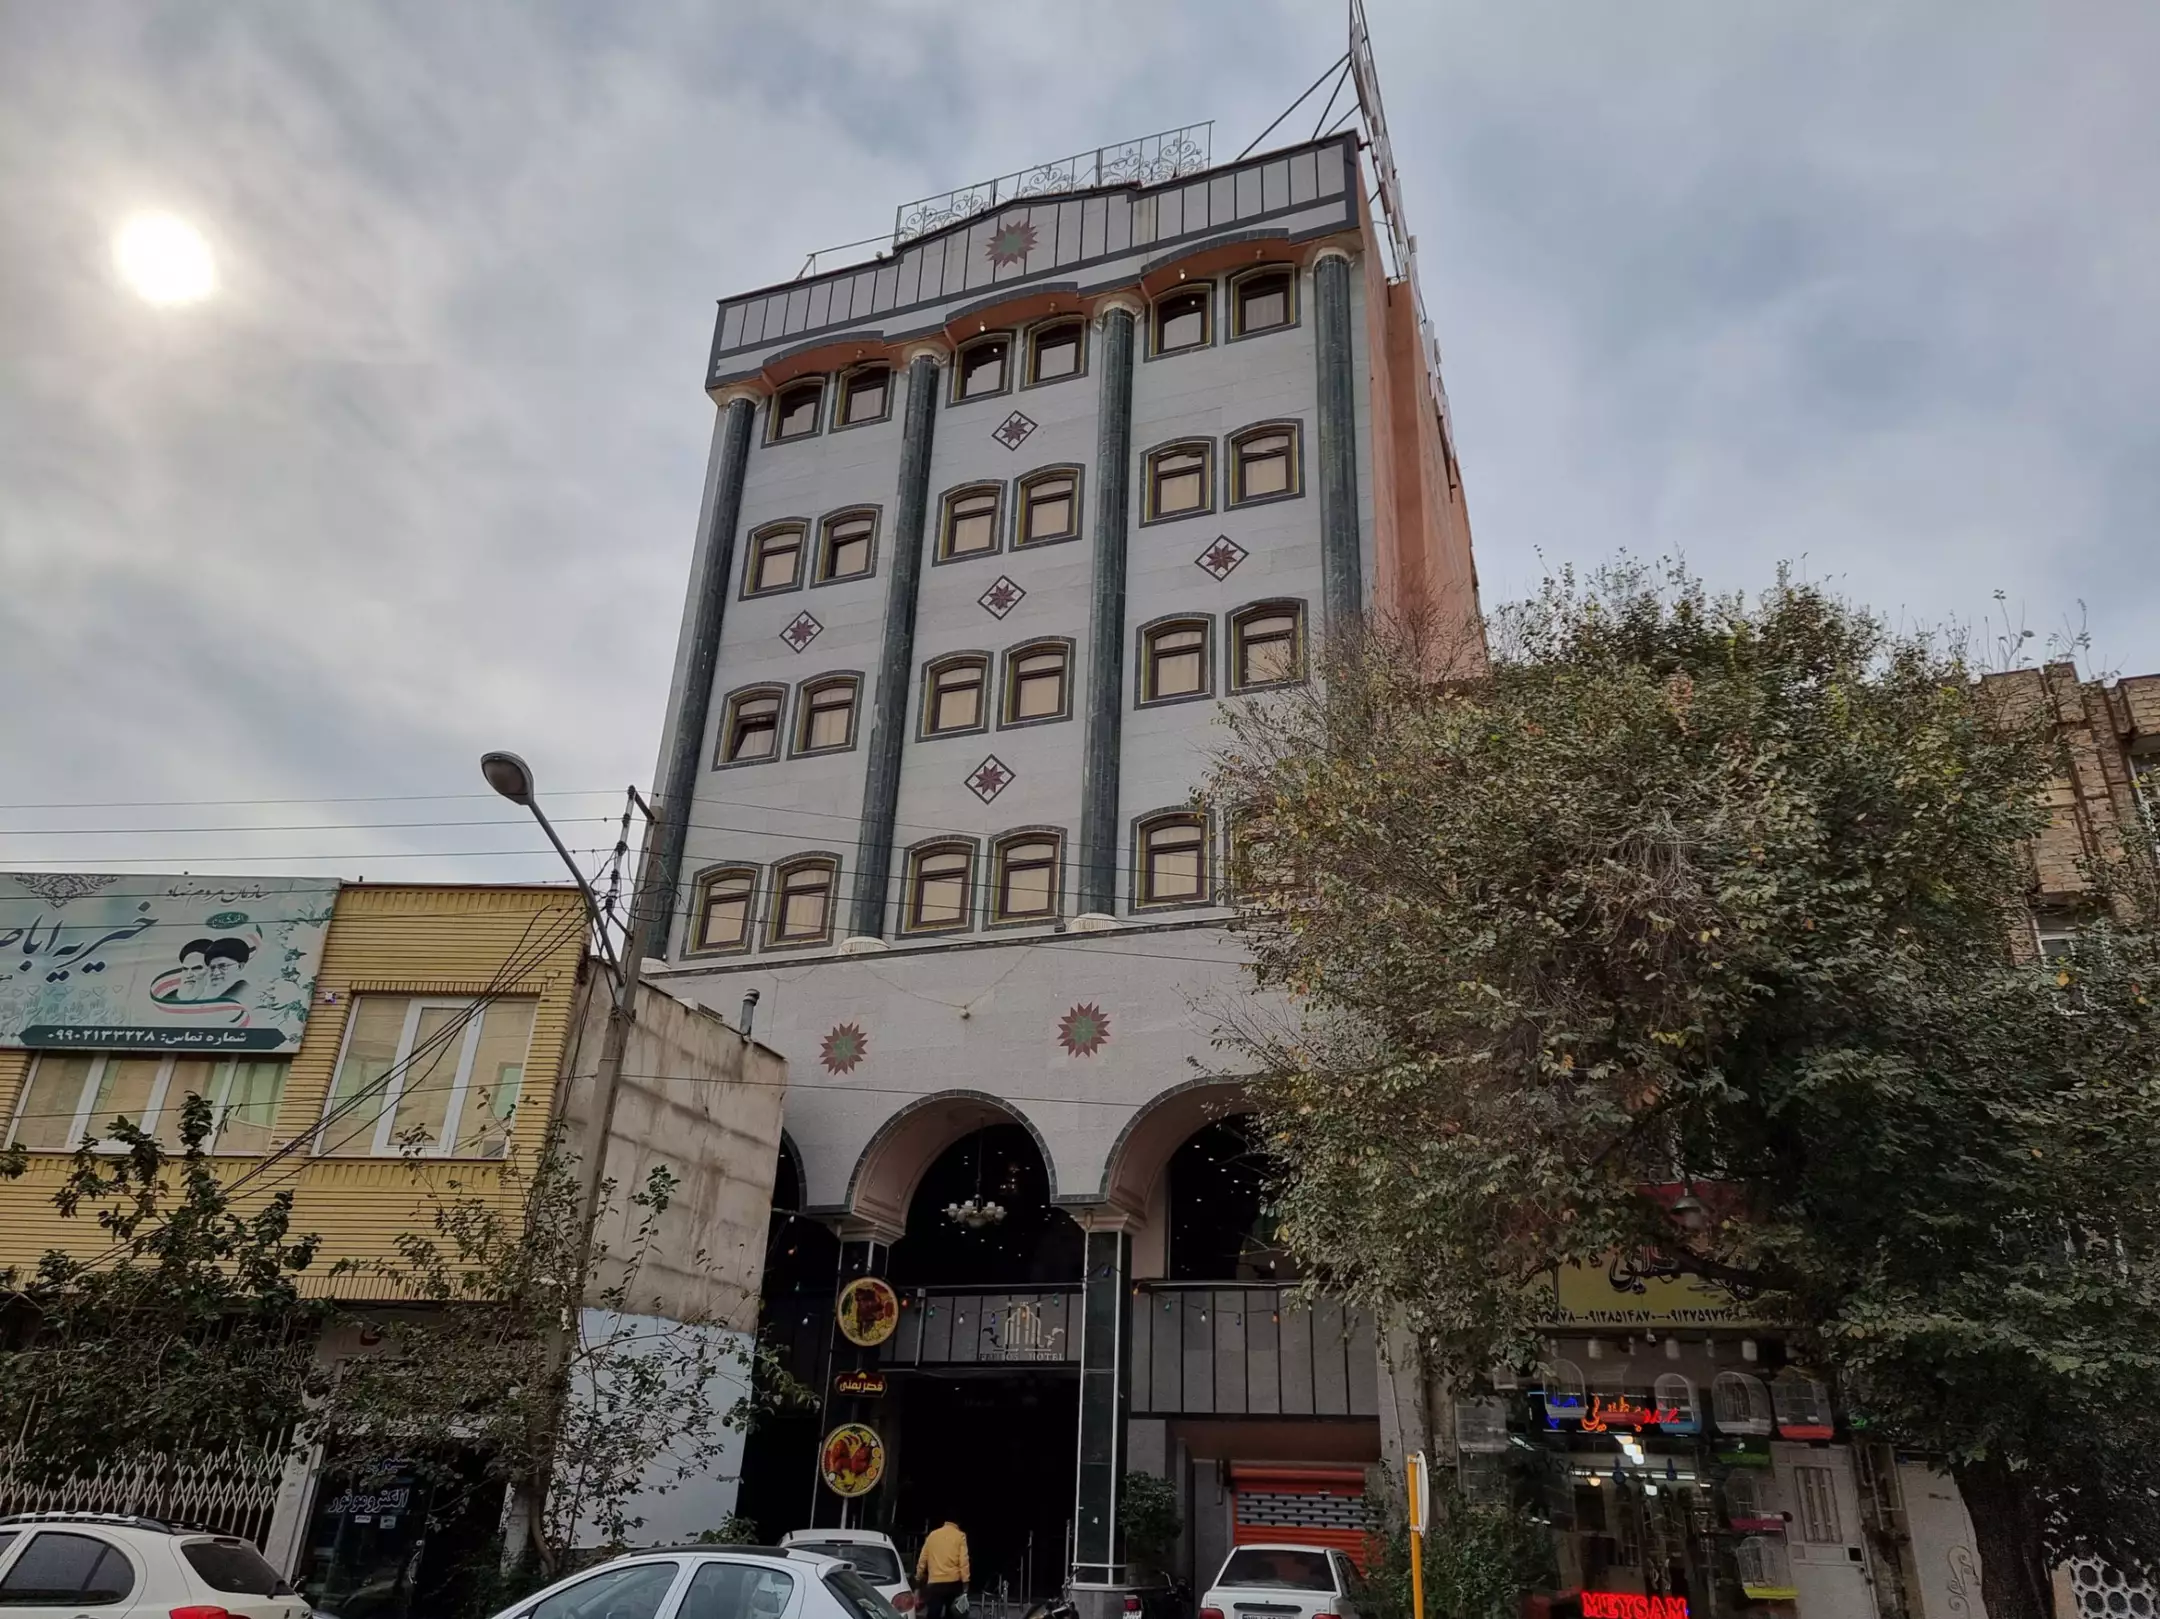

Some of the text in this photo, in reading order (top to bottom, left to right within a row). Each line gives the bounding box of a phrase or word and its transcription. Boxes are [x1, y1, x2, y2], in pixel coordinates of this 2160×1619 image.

[220, 884, 271, 903] سازمان
[46, 901, 160, 983] خیریه
[160, 1031, 204, 1045] تماس:
[205, 1031, 247, 1046] شماره
[1029, 1353, 1065, 1361] HOTEL
[860, 1380, 884, 1394] قصر
[328, 1487, 411, 1514] الکتروموتور
[1580, 1590, 1688, 1619] MEYSAM
